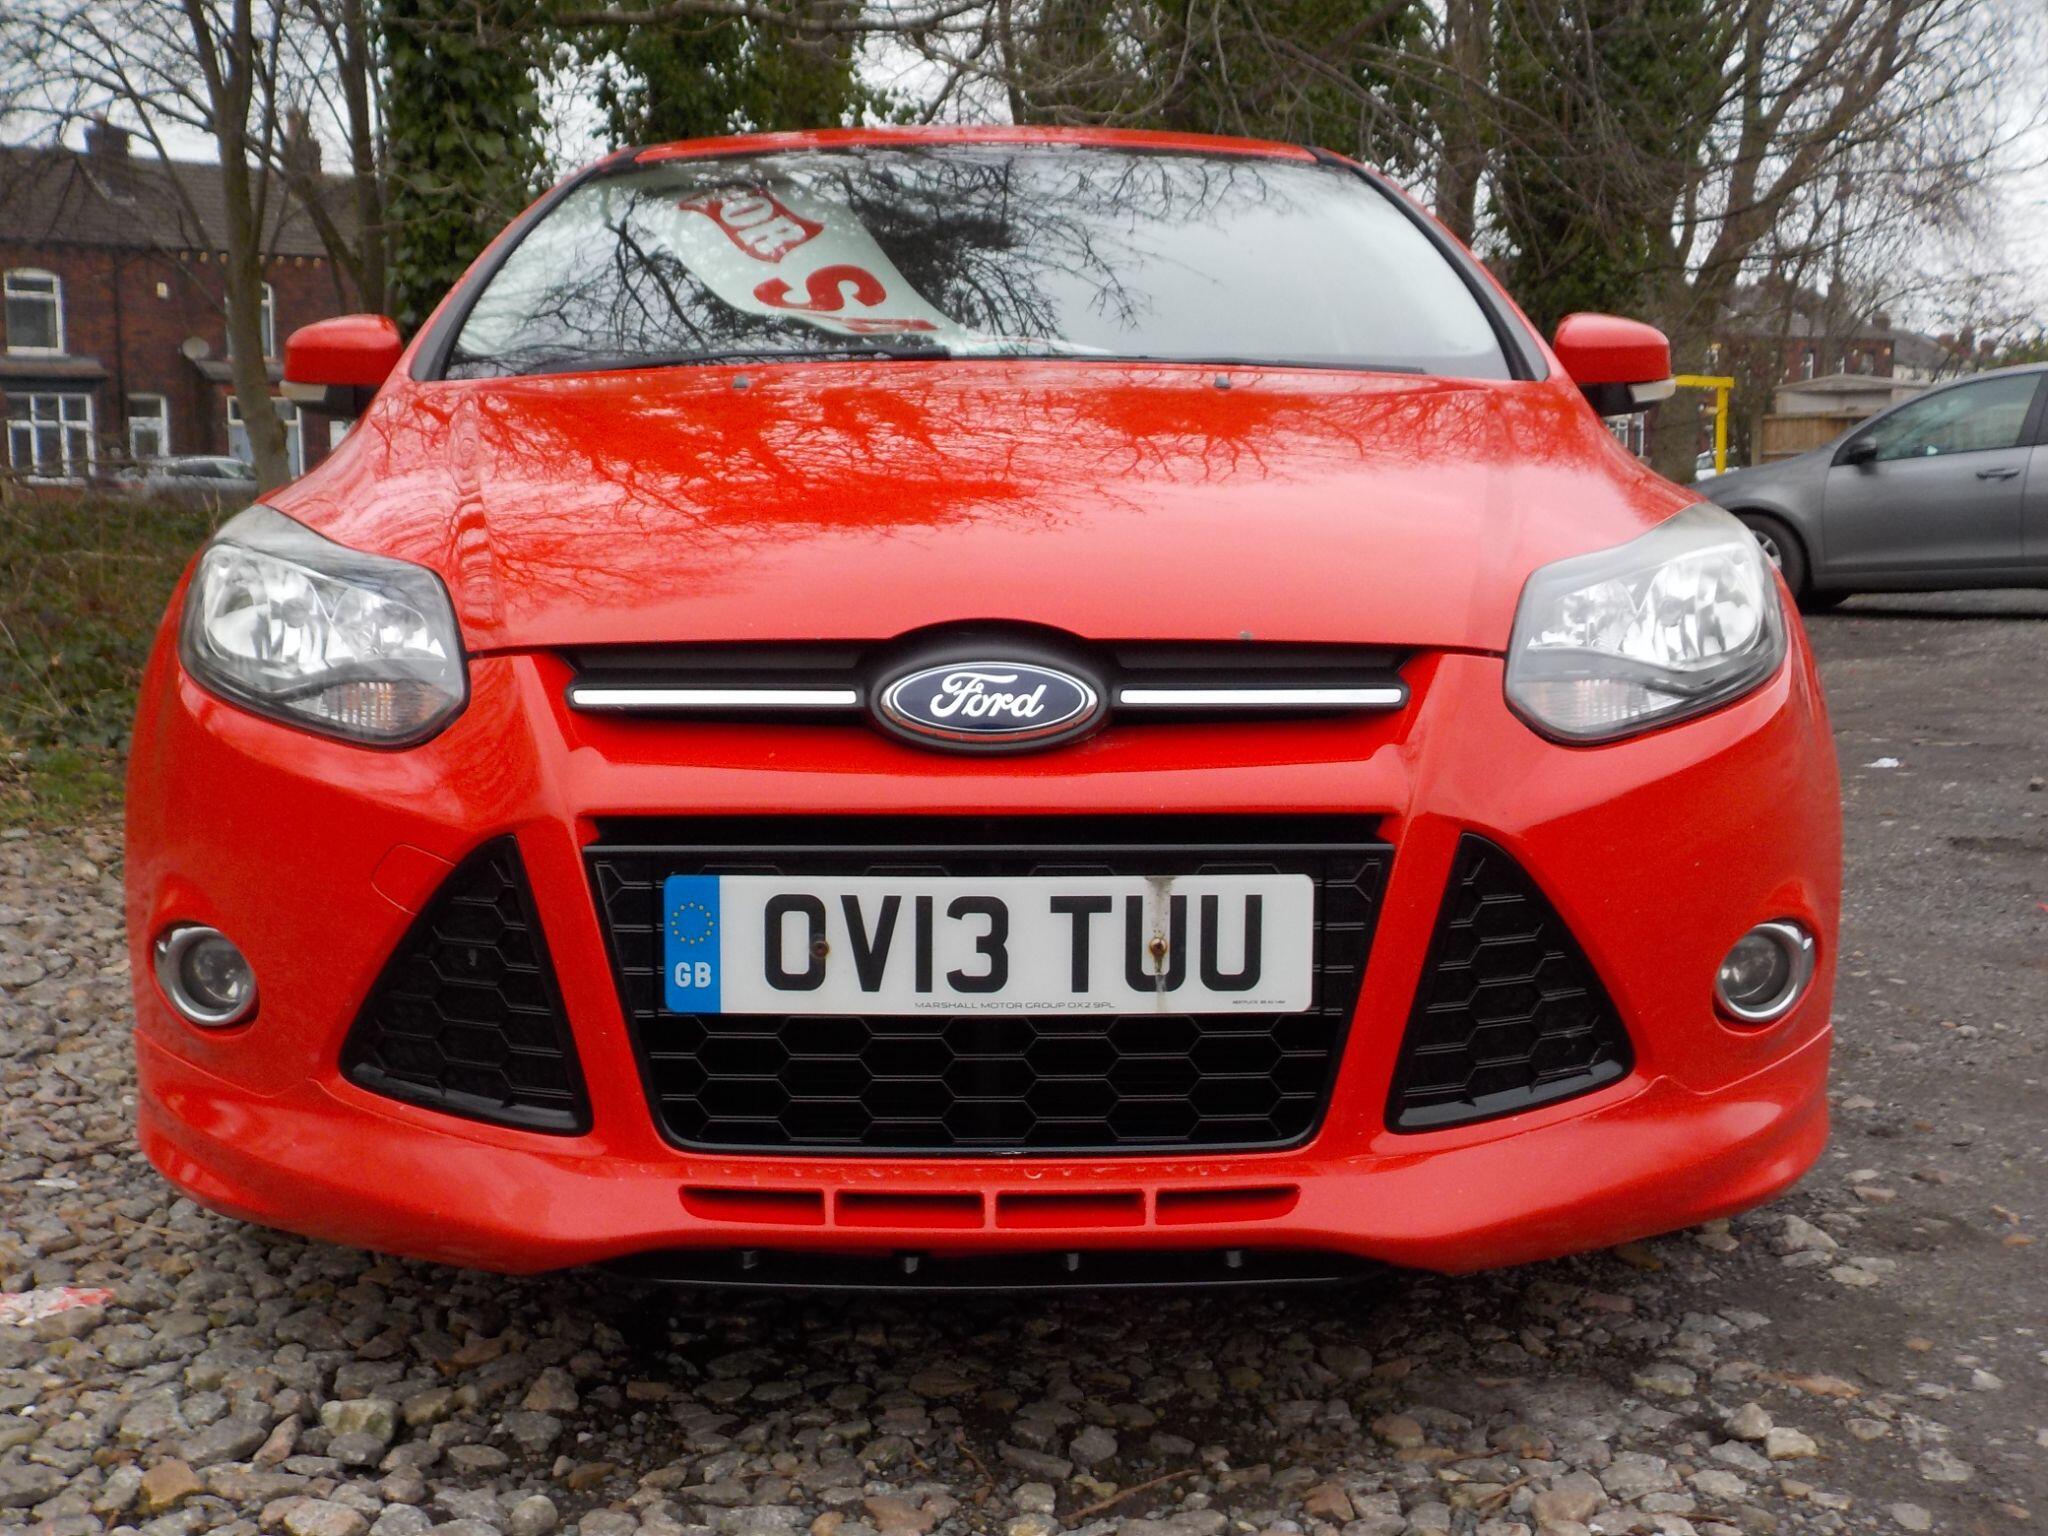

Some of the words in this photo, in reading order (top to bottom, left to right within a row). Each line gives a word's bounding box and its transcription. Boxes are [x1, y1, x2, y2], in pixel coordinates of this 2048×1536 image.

[930, 672, 1047, 718] Ford
[765, 894, 1009, 993] OV13
[1050, 894, 1262, 992] TUU
[675, 962, 711, 988] GB
[914, 1001, 978, 1009] MARSHALL
[980, 1001, 1023, 1009] MOTOR
[1025, 1001, 1066, 1009] GROUP
